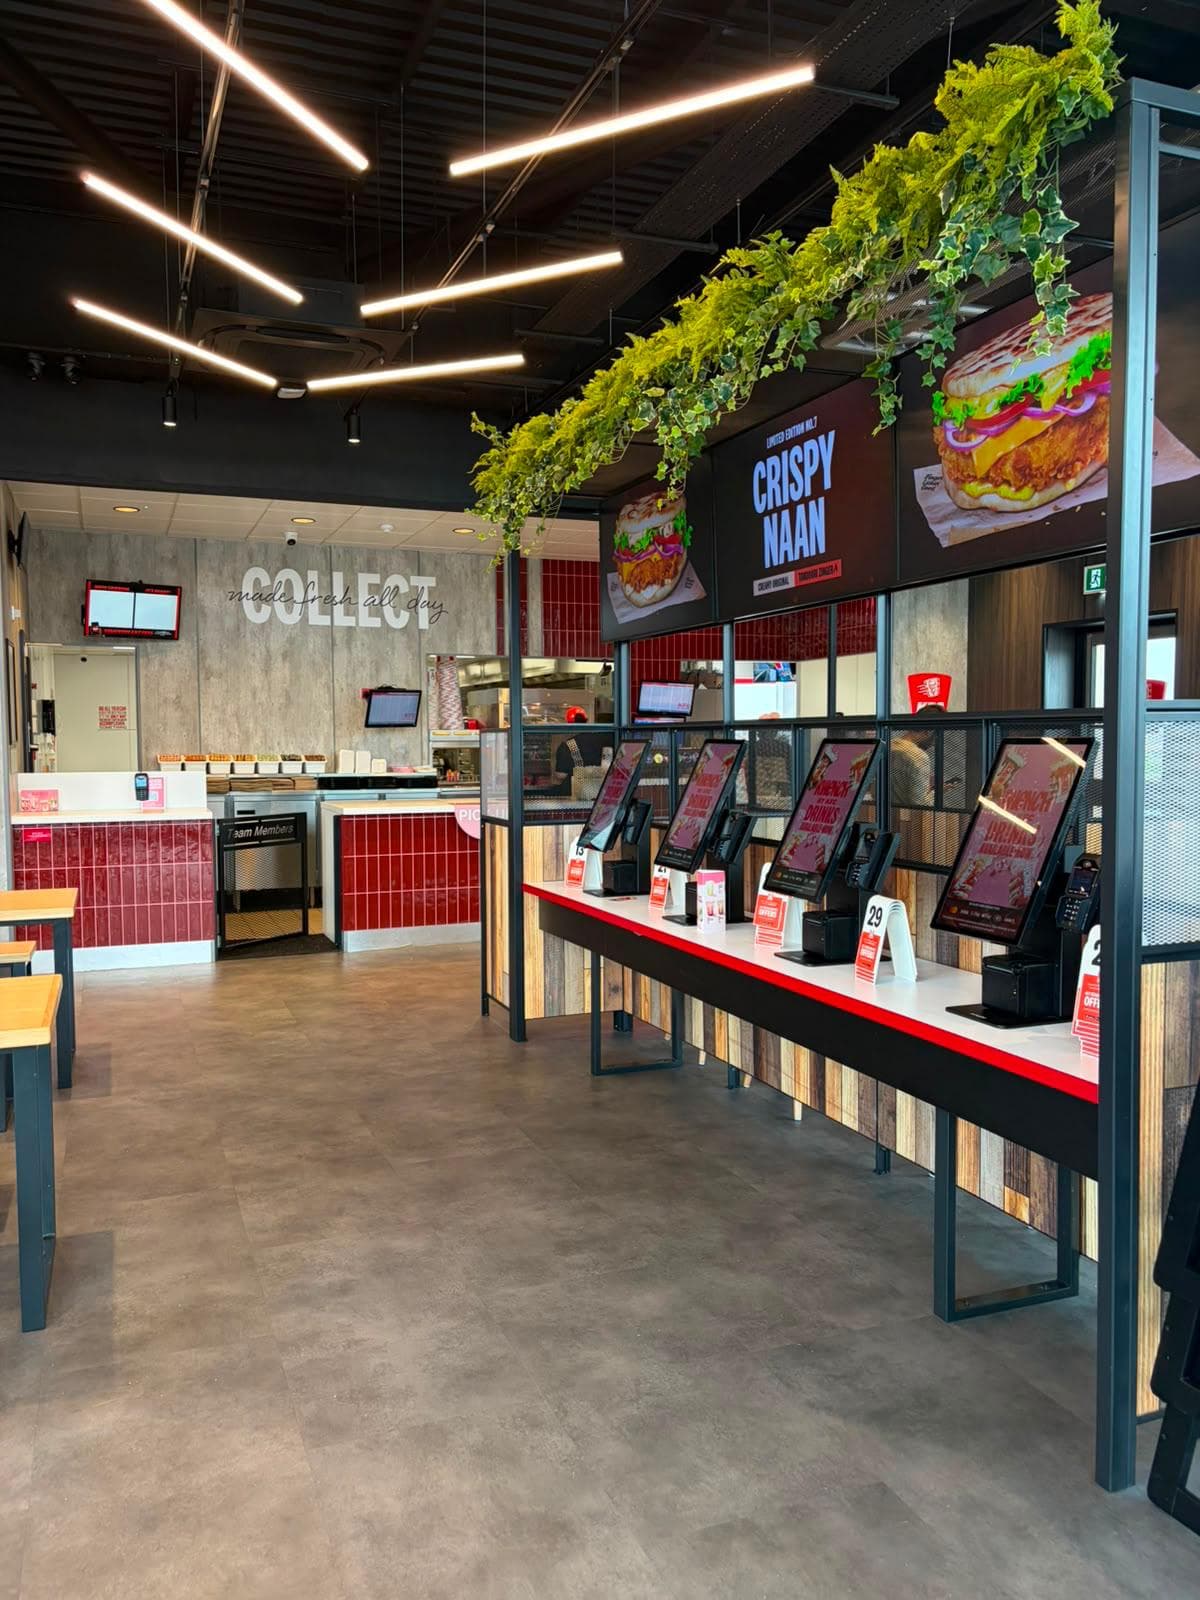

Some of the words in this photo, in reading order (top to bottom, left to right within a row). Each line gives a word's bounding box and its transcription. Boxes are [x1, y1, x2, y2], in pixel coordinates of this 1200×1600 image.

[766, 431, 785, 449] LIMITED
[785, 422, 804, 441] EDITION
[752, 429, 836, 514] CRISPY
[763, 496, 826, 569] NAAN
[228, 580, 294, 603] made
[295, 580, 358, 617] fresh
[363, 583, 399, 608] all
[406, 586, 449, 624] day
[241, 566, 437, 630] COLLECT
[228, 828, 252, 840] Team
[253, 824, 294, 837] Members
[804, 805, 841, 825] DRINKS
[867, 905, 883, 927] 29
